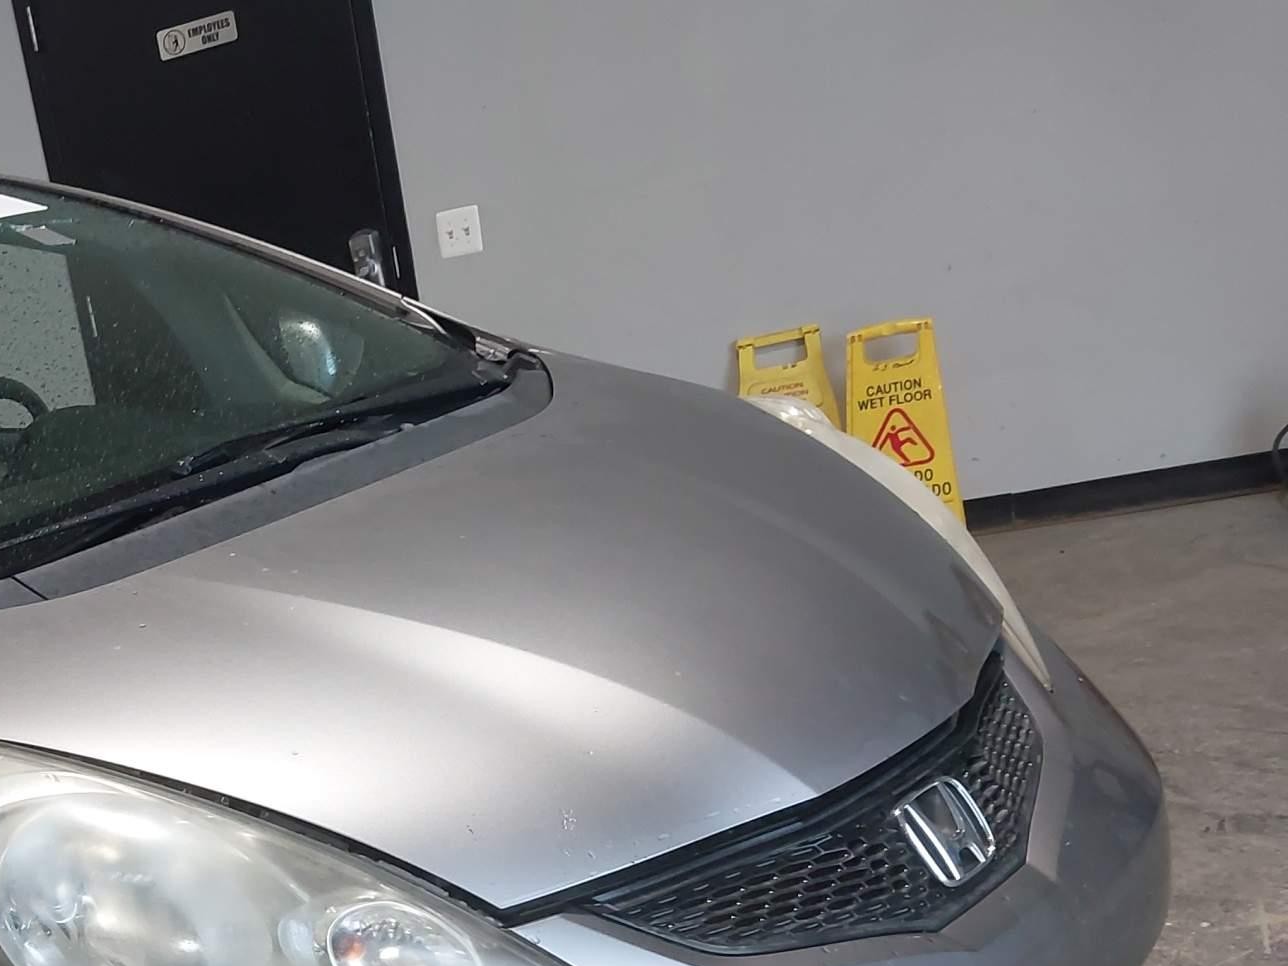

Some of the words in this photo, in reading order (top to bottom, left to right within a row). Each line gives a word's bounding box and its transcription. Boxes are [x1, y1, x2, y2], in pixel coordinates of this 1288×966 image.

[187, 18, 230, 38] EMPLOYEES
[201, 32, 219, 45] ONLY
[761, 382, 804, 395] CAUTION
[866, 378, 922, 397] CAUTION
[857, 396, 884, 411] WET
[888, 388, 932, 405] FLOOR
